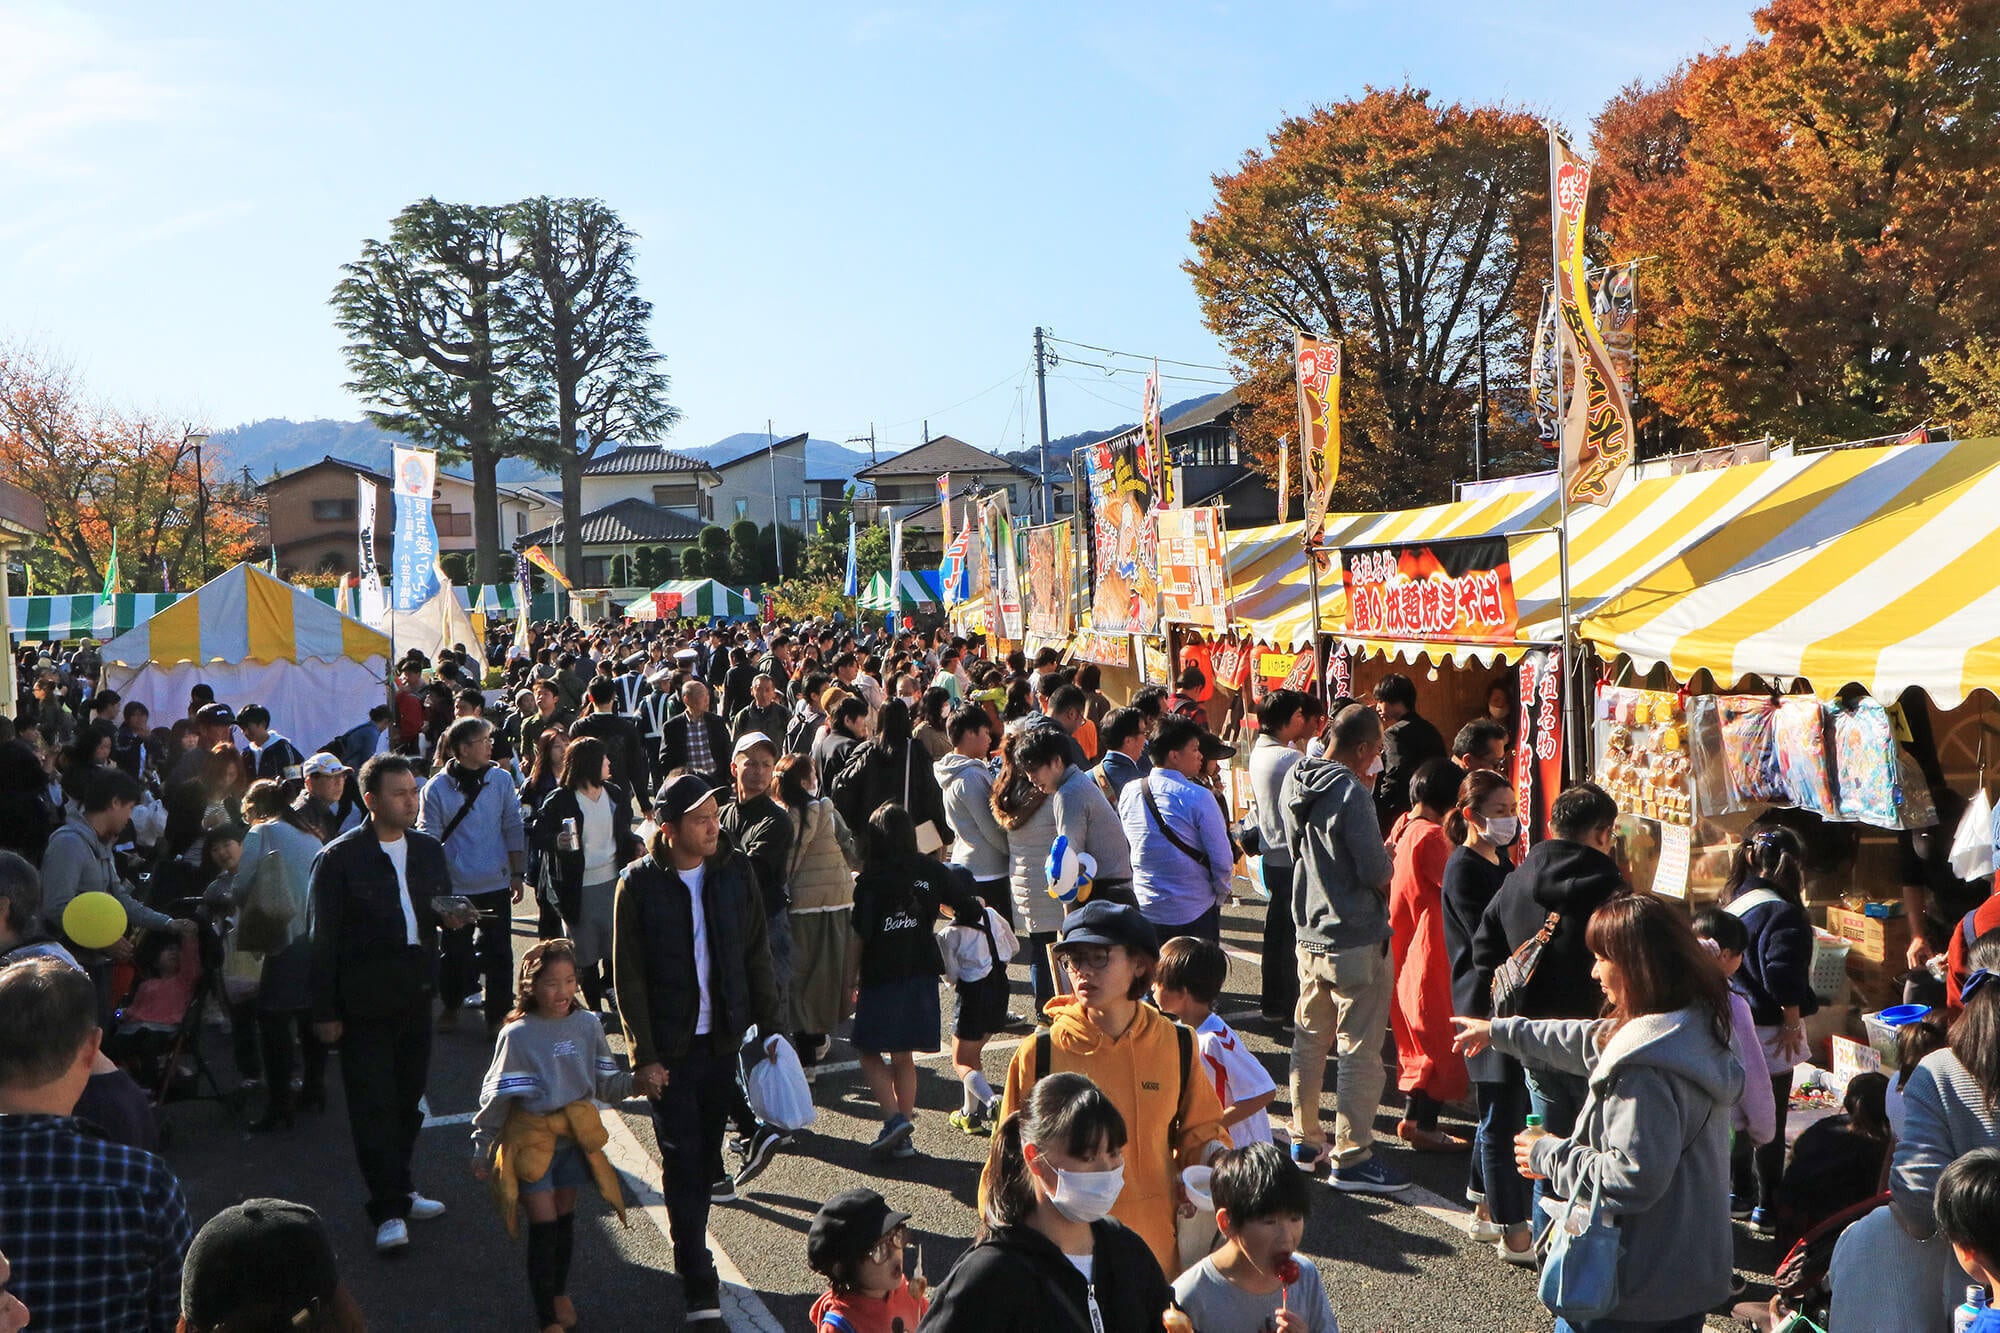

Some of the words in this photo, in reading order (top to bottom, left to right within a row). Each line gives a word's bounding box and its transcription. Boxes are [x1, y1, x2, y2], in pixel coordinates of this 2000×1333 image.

[1351, 550, 1397, 585] 元祖名物
[1352, 569, 1505, 635] 盛り放題焼きそば
[1536, 647, 1561, 760] 元祖名物
[1141, 1081, 1160, 1091] VANS
